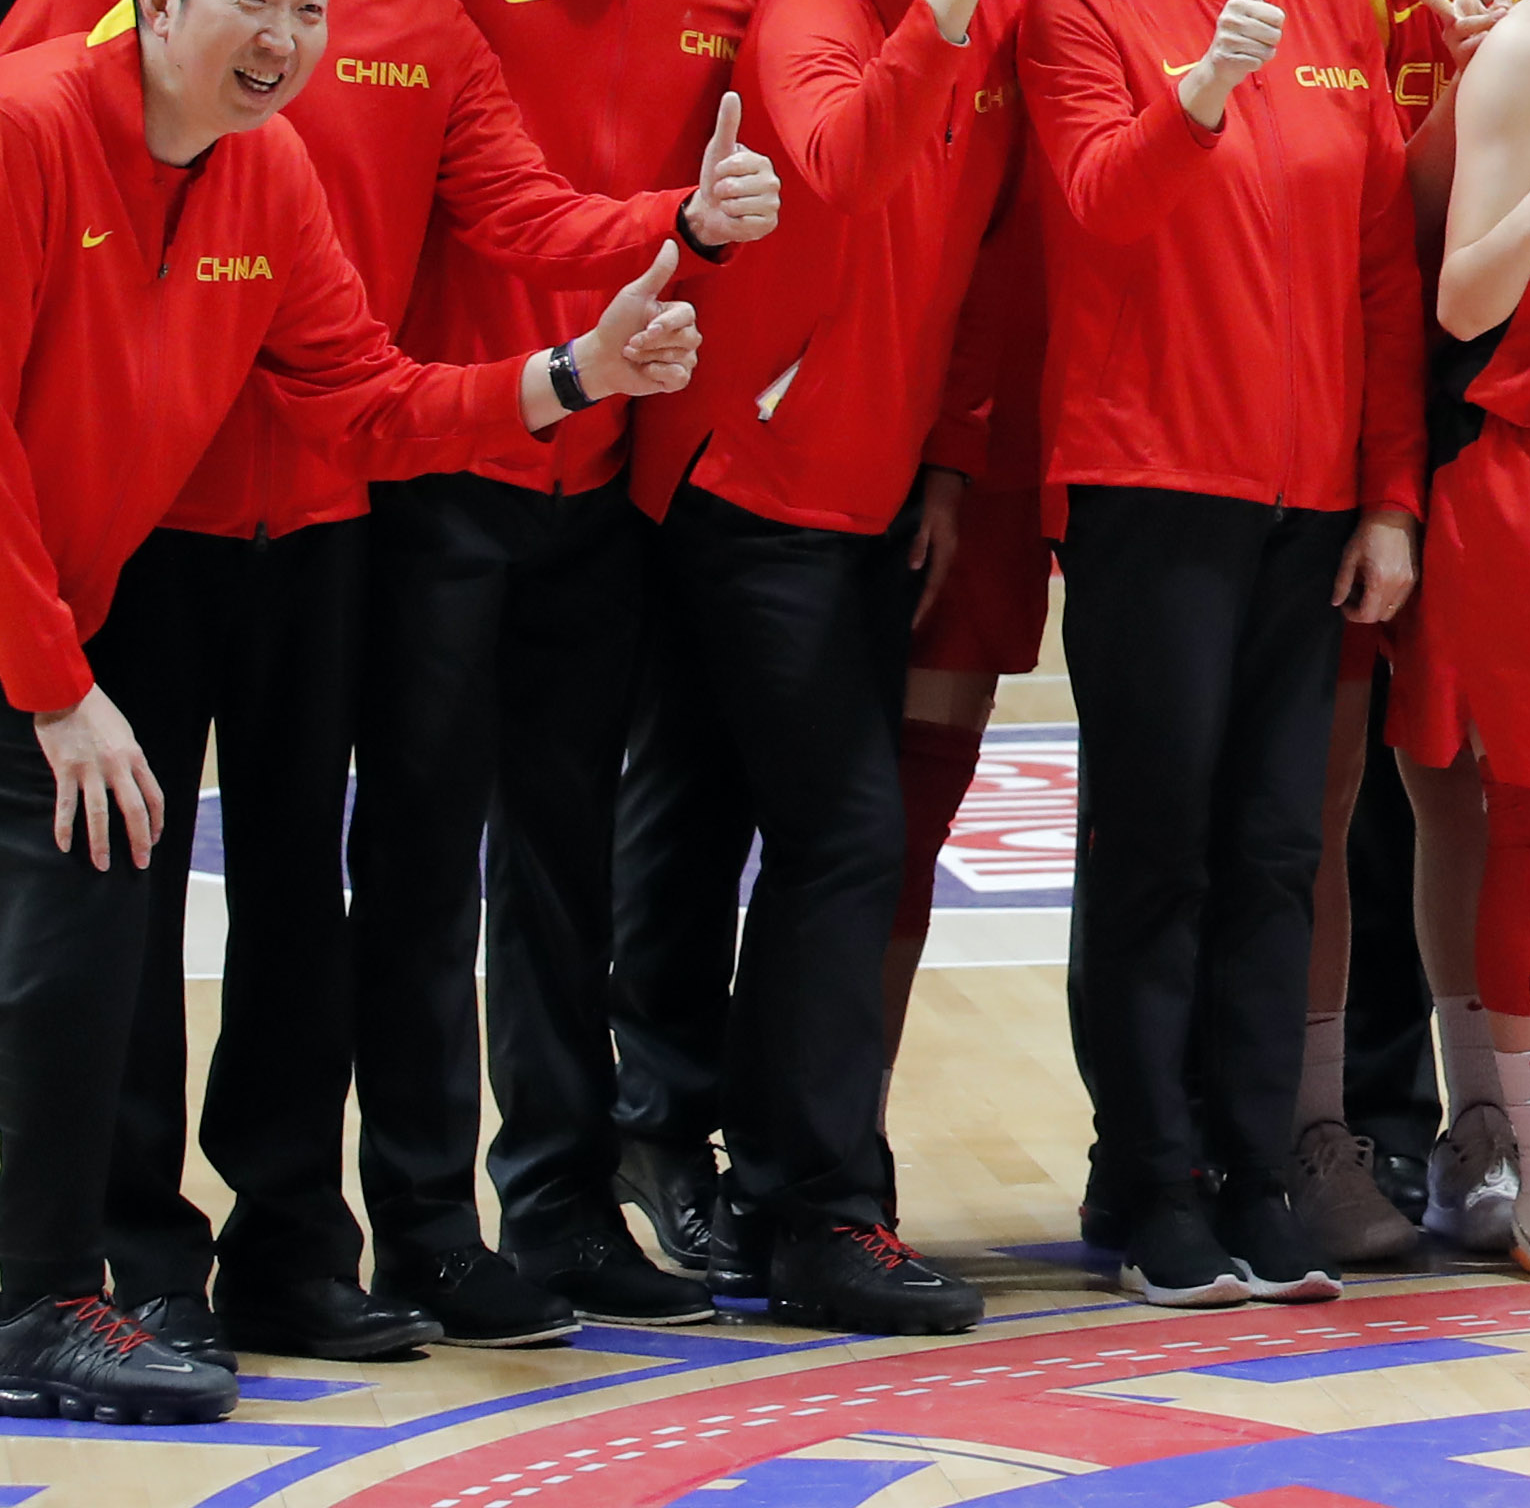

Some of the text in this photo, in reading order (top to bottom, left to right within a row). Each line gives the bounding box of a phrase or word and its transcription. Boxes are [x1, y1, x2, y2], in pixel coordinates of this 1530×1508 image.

[680, 29, 738, 61] CHIN
[336, 58, 430, 89] CHINA
[1295, 65, 1369, 91] CHINA
